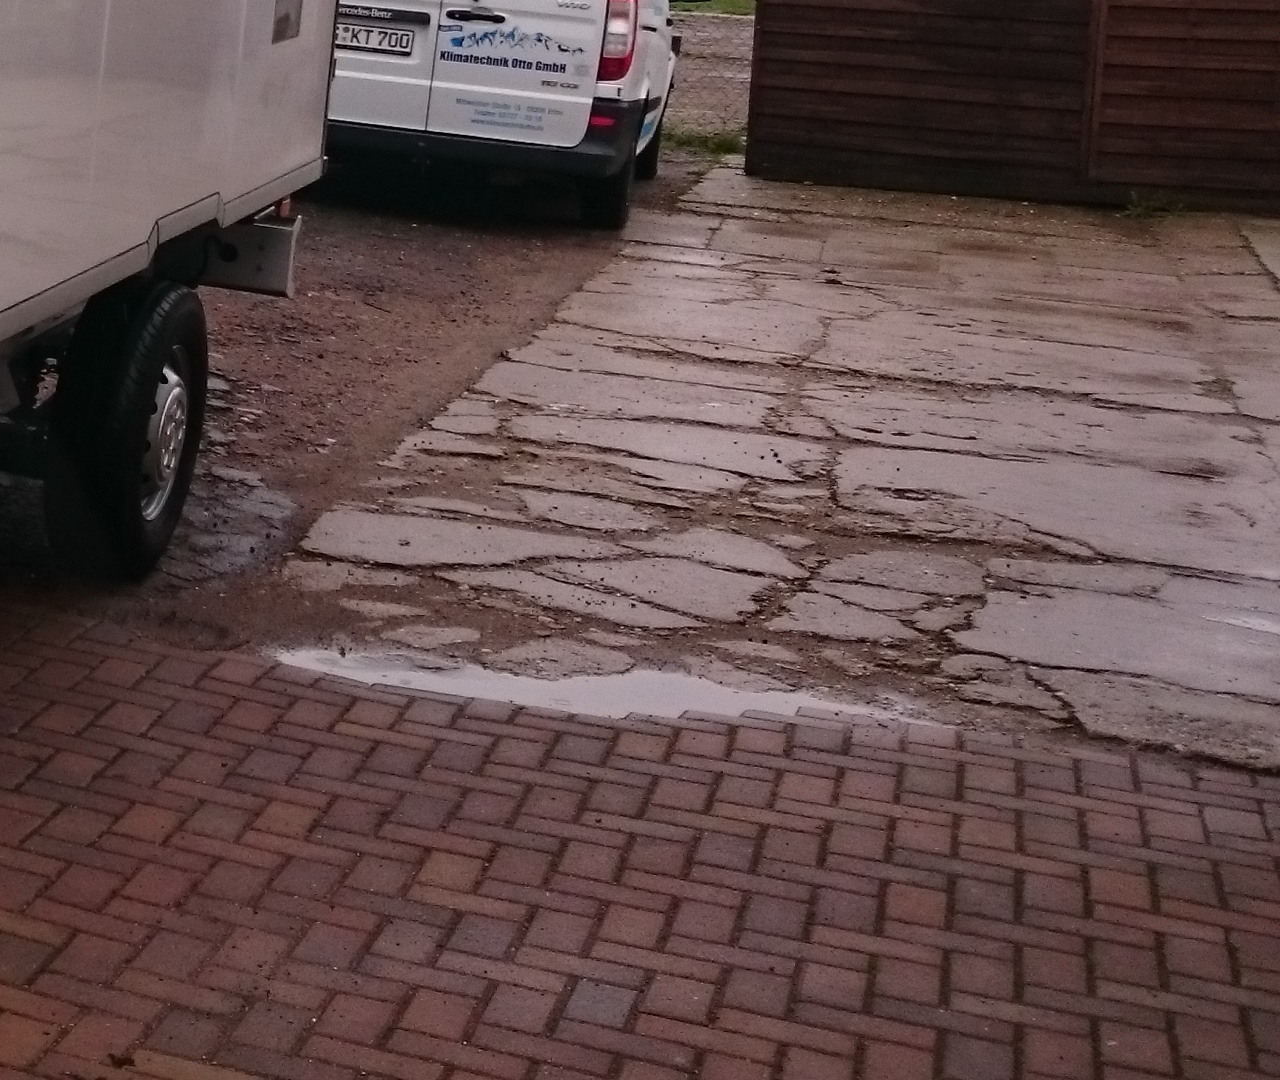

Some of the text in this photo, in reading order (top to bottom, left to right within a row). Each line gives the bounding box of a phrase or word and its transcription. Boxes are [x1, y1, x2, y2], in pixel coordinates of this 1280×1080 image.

[338, 6, 393, 19] ercedes-Benz
[350, 27, 375, 45] KT
[377, 30, 410, 49] 700
[439, 50, 567, 74] Klimatechnik Otto GmbH
